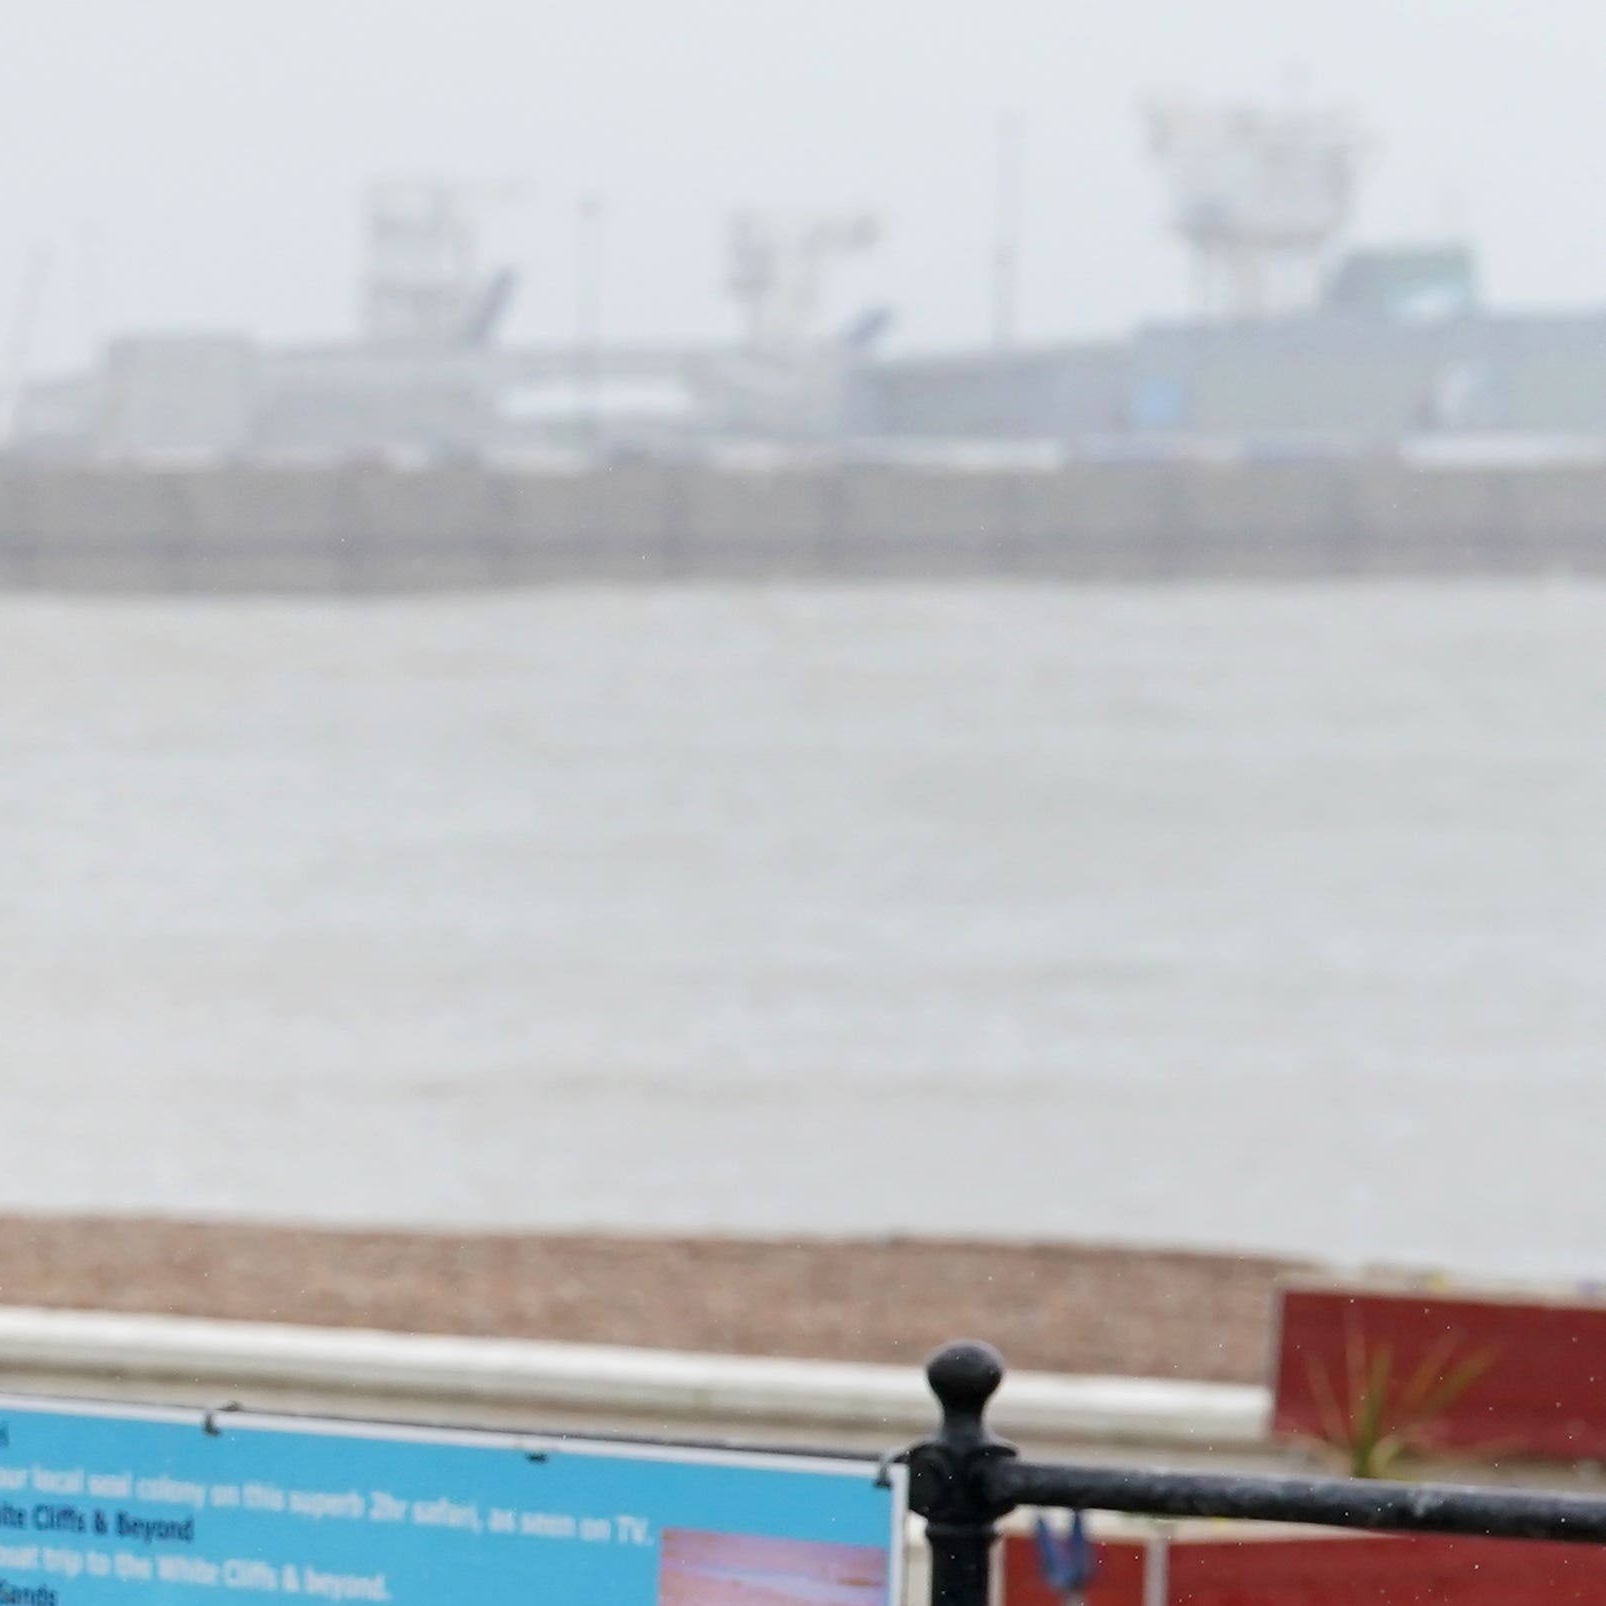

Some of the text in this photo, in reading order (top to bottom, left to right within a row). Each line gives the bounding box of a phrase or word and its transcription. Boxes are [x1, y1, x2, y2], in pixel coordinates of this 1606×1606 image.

[33, 1465, 84, 1494] local
[89, 1471, 132, 1497] seal
[137, 1477, 206, 1509] colony
[210, 1485, 239, 1506] on
[243, 1482, 284, 1511] this
[290, 1489, 364, 1520] superb
[491, 1508, 516, 1532] as
[521, 1511, 576, 1537] seen
[581, 1518, 611, 1541] on
[33, 1504, 86, 1533] Cliffs
[92, 1509, 108, 1534] &
[115, 1510, 194, 1543] Beyond
[42, 1547, 83, 1578] trip
[87, 1551, 110, 1575] to
[115, 1553, 152, 1580] the
[157, 1556, 218, 1586] White
[223, 1559, 277, 1590] Cliffs
[282, 1564, 299, 1592] &
